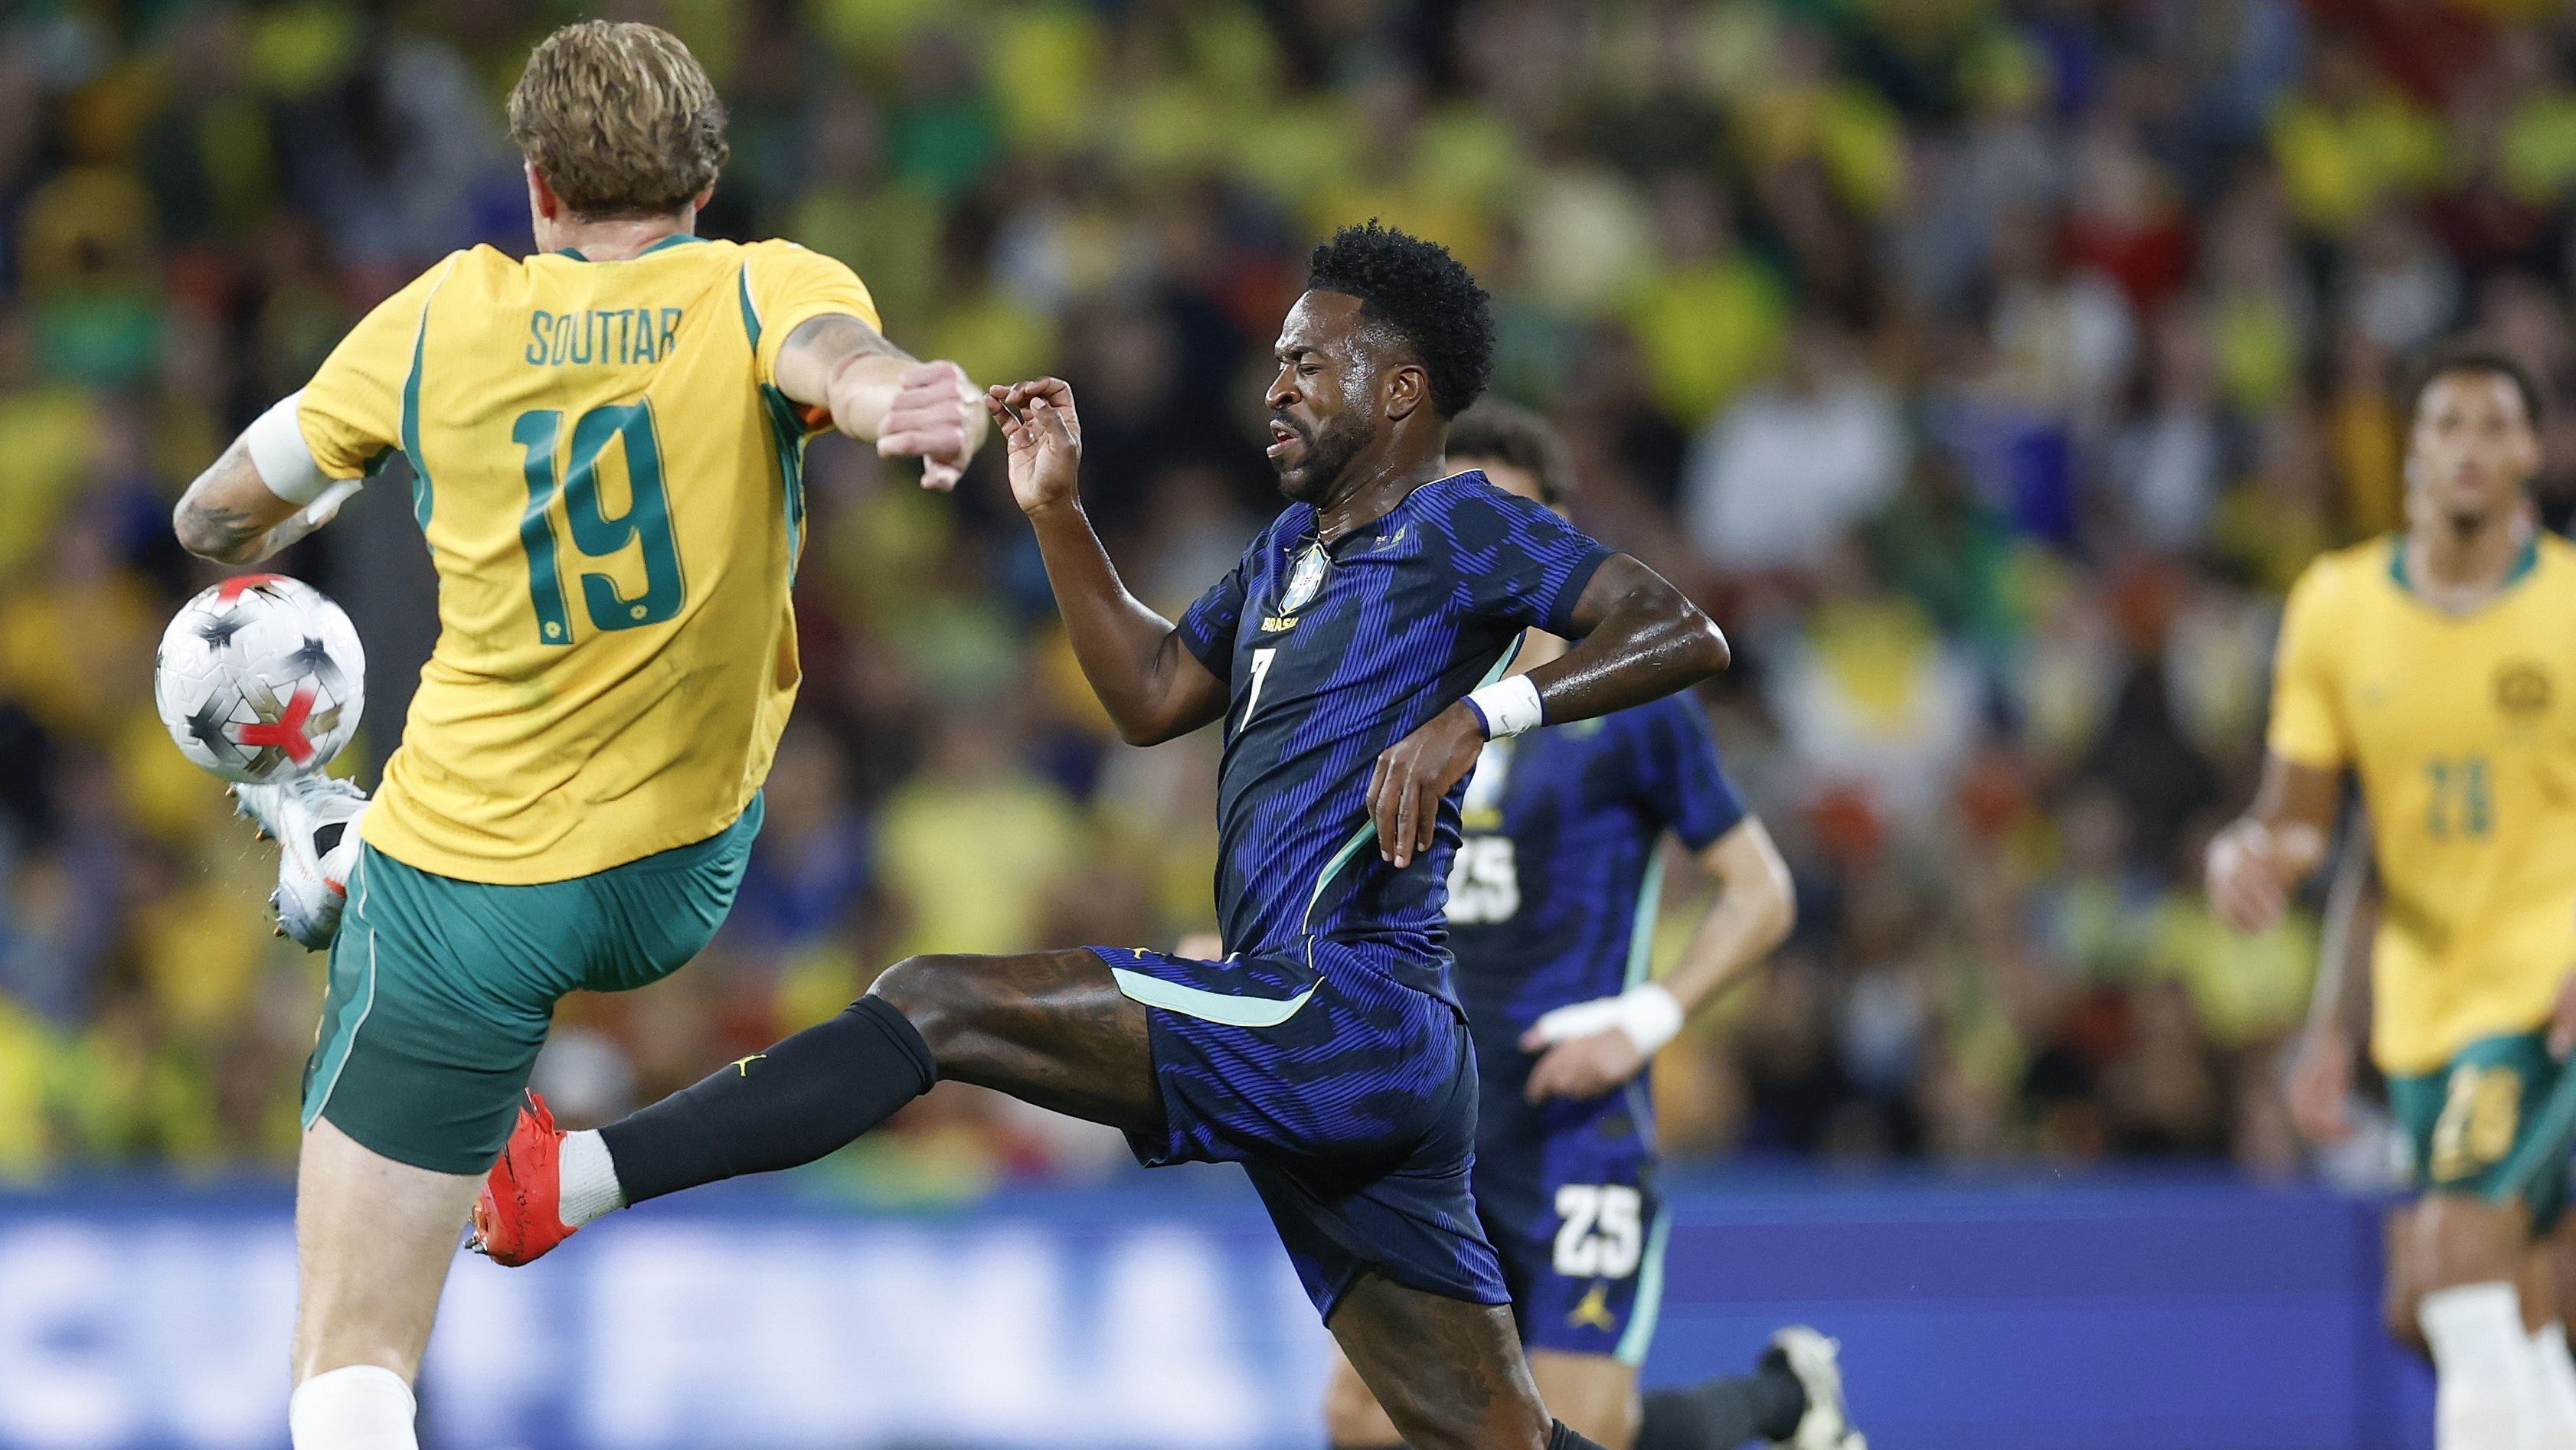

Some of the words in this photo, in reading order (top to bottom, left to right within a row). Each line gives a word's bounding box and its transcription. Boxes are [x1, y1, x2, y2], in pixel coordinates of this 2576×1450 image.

[526, 309, 682, 365] SOUTTAR
[512, 394, 686, 644] 19
[1241, 648, 1277, 733] 7
[1553, 1184, 1642, 1277] 25
